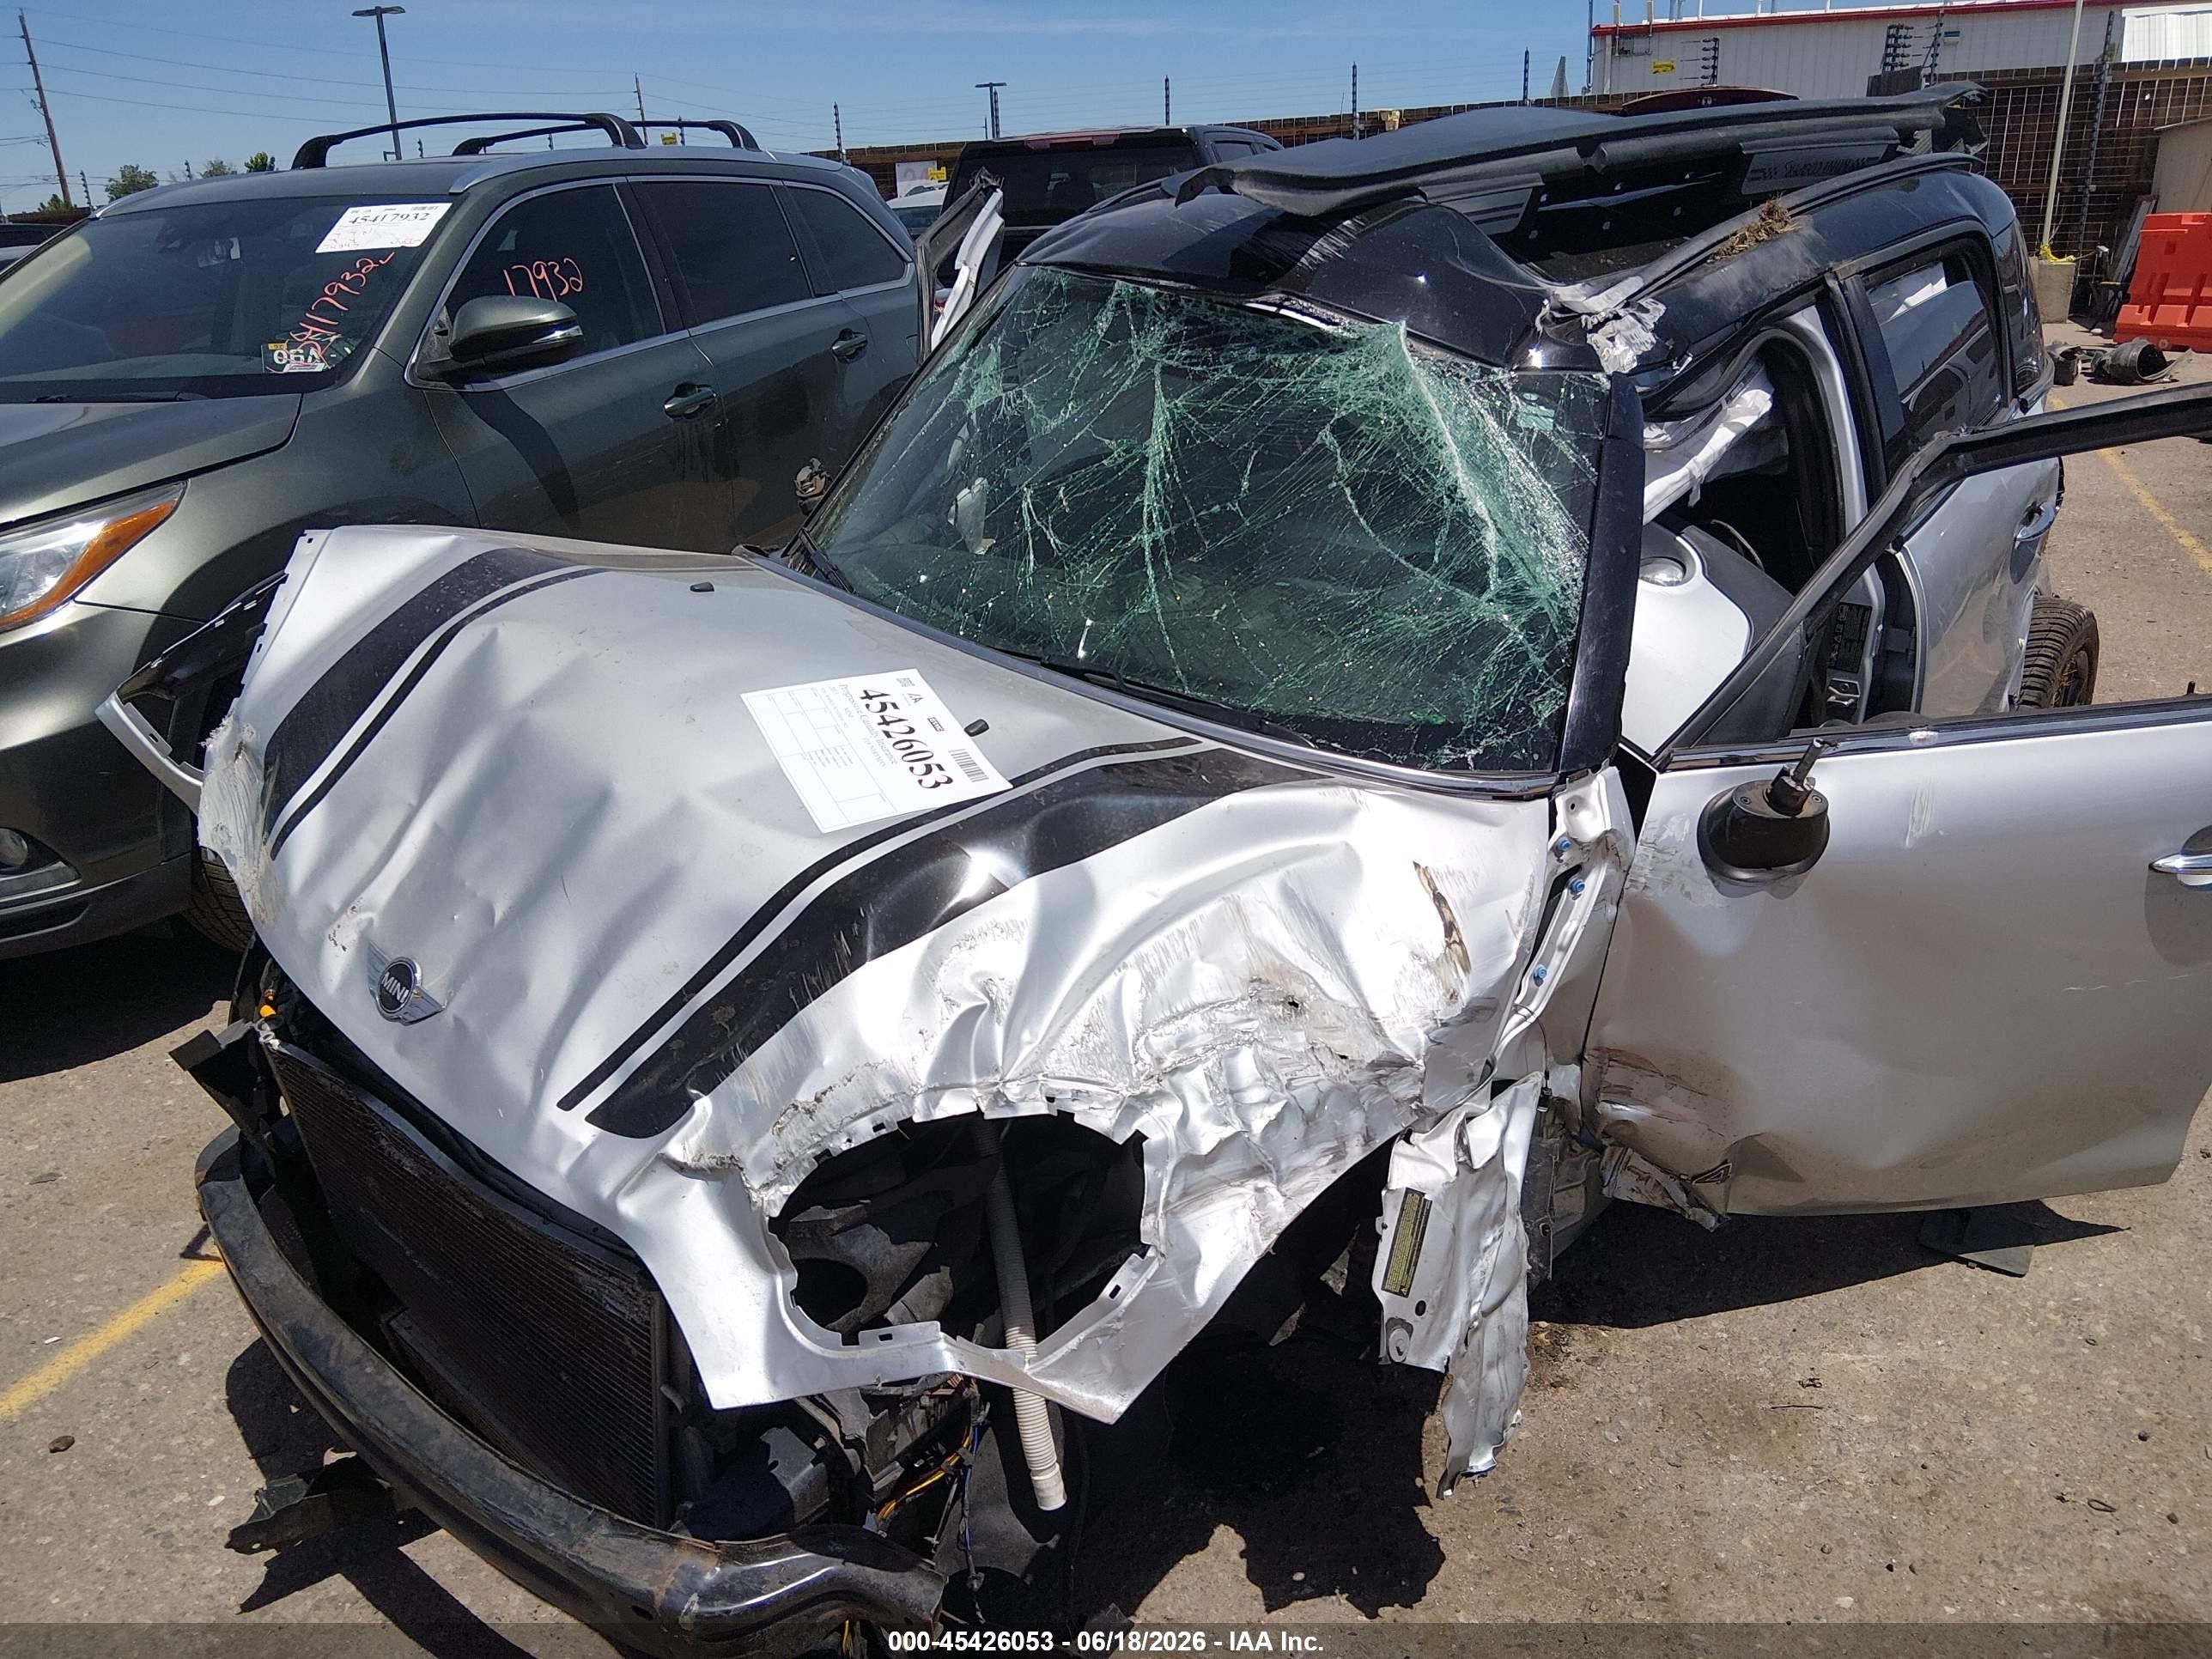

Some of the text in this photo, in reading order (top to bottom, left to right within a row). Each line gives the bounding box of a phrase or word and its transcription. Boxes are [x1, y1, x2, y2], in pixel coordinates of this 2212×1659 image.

[349, 212, 430, 224] 45417932
[503, 258, 583, 302] 17932
[860, 690, 953, 788] 45426053
[381, 972, 410, 1003] MINI
